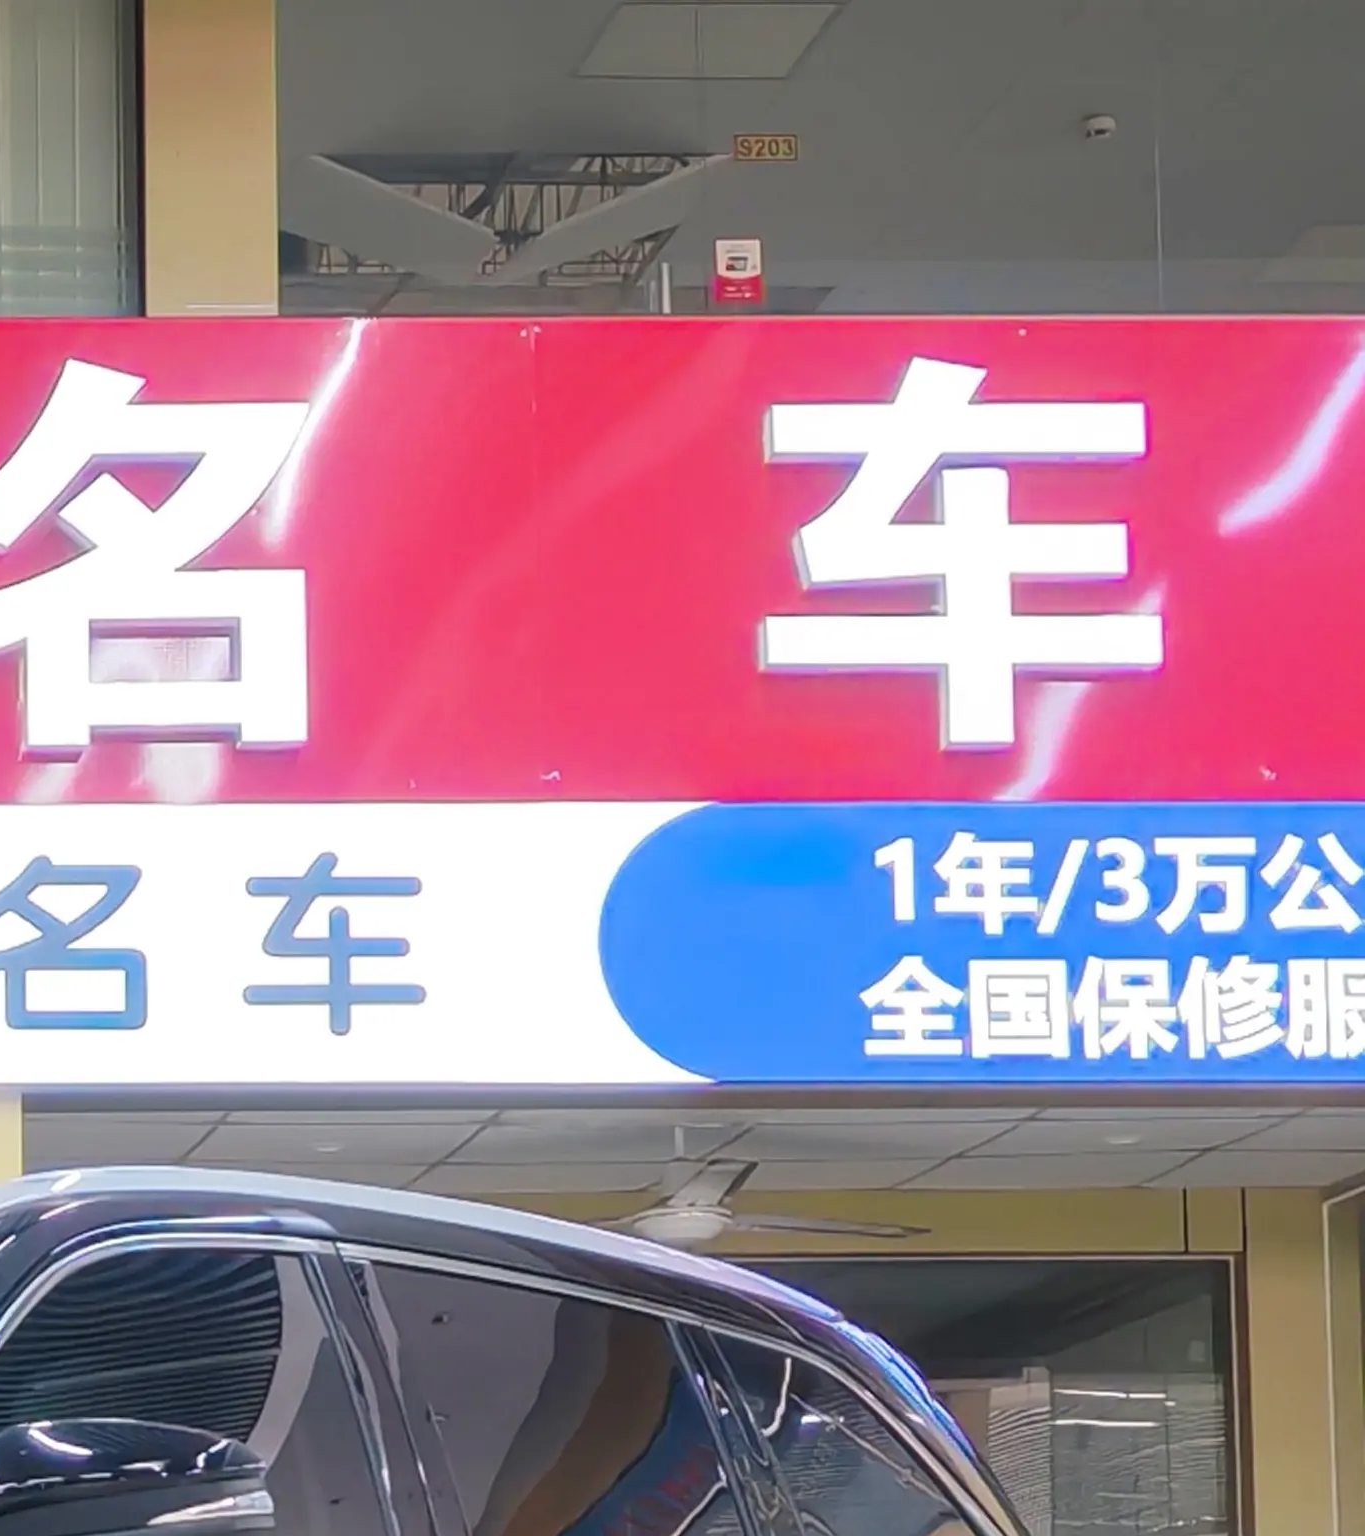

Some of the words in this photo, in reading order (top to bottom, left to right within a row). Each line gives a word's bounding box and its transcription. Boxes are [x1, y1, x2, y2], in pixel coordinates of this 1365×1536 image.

[874, 831, 1364, 936] 1年/3万公
[858, 954, 1365, 1060] 全国保修服
